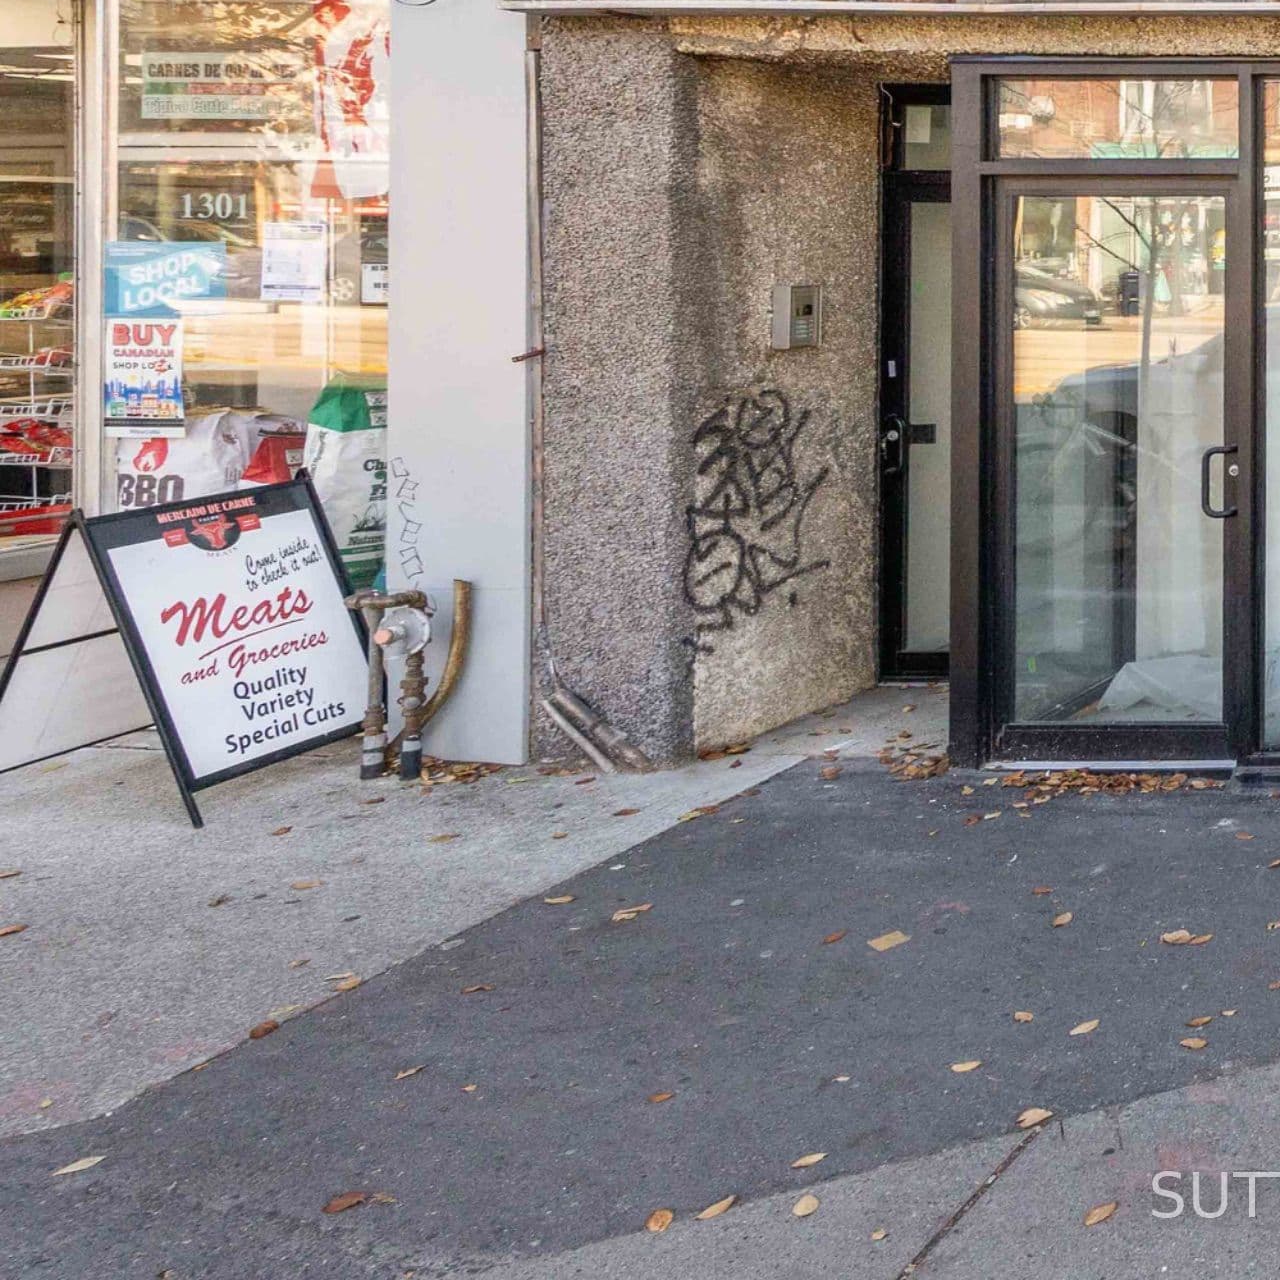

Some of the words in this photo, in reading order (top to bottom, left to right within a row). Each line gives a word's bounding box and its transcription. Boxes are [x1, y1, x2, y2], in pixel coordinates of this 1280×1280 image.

[148, 63, 200, 78] CARNES
[204, 63, 222, 78] DE
[181, 193, 249, 219] 1301
[128, 253, 196, 286] SHOP
[124, 277, 201, 310] LOCAL
[113, 323, 177, 347] BUY
[113, 349, 175, 358] CANADIAN
[113, 362, 139, 370] SHOP
[156, 506, 207, 524] MERCADO
[207, 502, 222, 514] DE
[222, 495, 256, 511] CARNE
[246, 553, 277, 575] Come
[279, 536, 309, 559] inside
[246, 579, 259, 592] to
[261, 560, 289, 585] check
[291, 558, 300, 571] it
[302, 544, 322, 566] out!
[161, 586, 313, 646] Meats
[181, 659, 218, 685] and
[228, 630, 329, 678] Groceries
[233, 667, 307, 700] Quality
[242, 687, 314, 721] Variety
[225, 713, 299, 754] Special
[303, 701, 346, 726] Cuts
